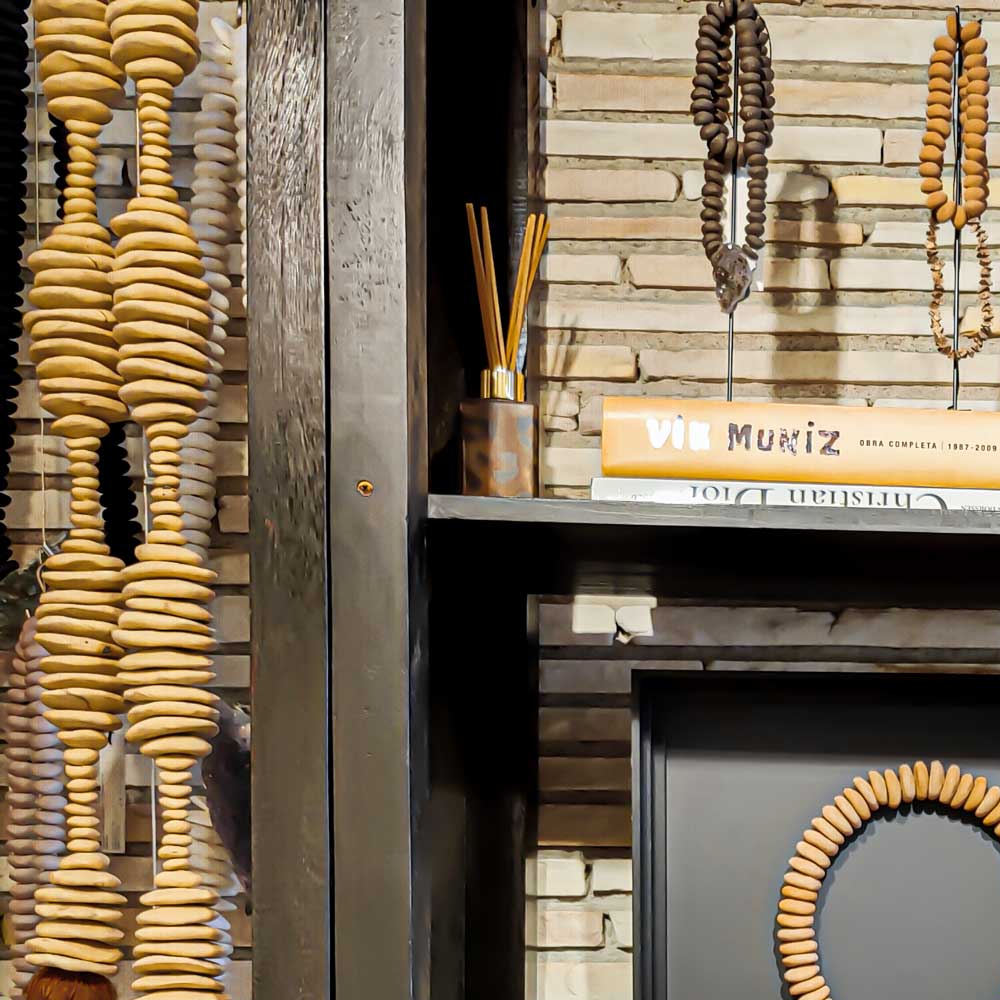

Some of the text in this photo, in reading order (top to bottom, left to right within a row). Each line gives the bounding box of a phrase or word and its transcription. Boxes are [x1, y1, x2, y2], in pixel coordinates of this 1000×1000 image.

[859, 439, 998, 452] OBRA COMPLETA 1987-2009
